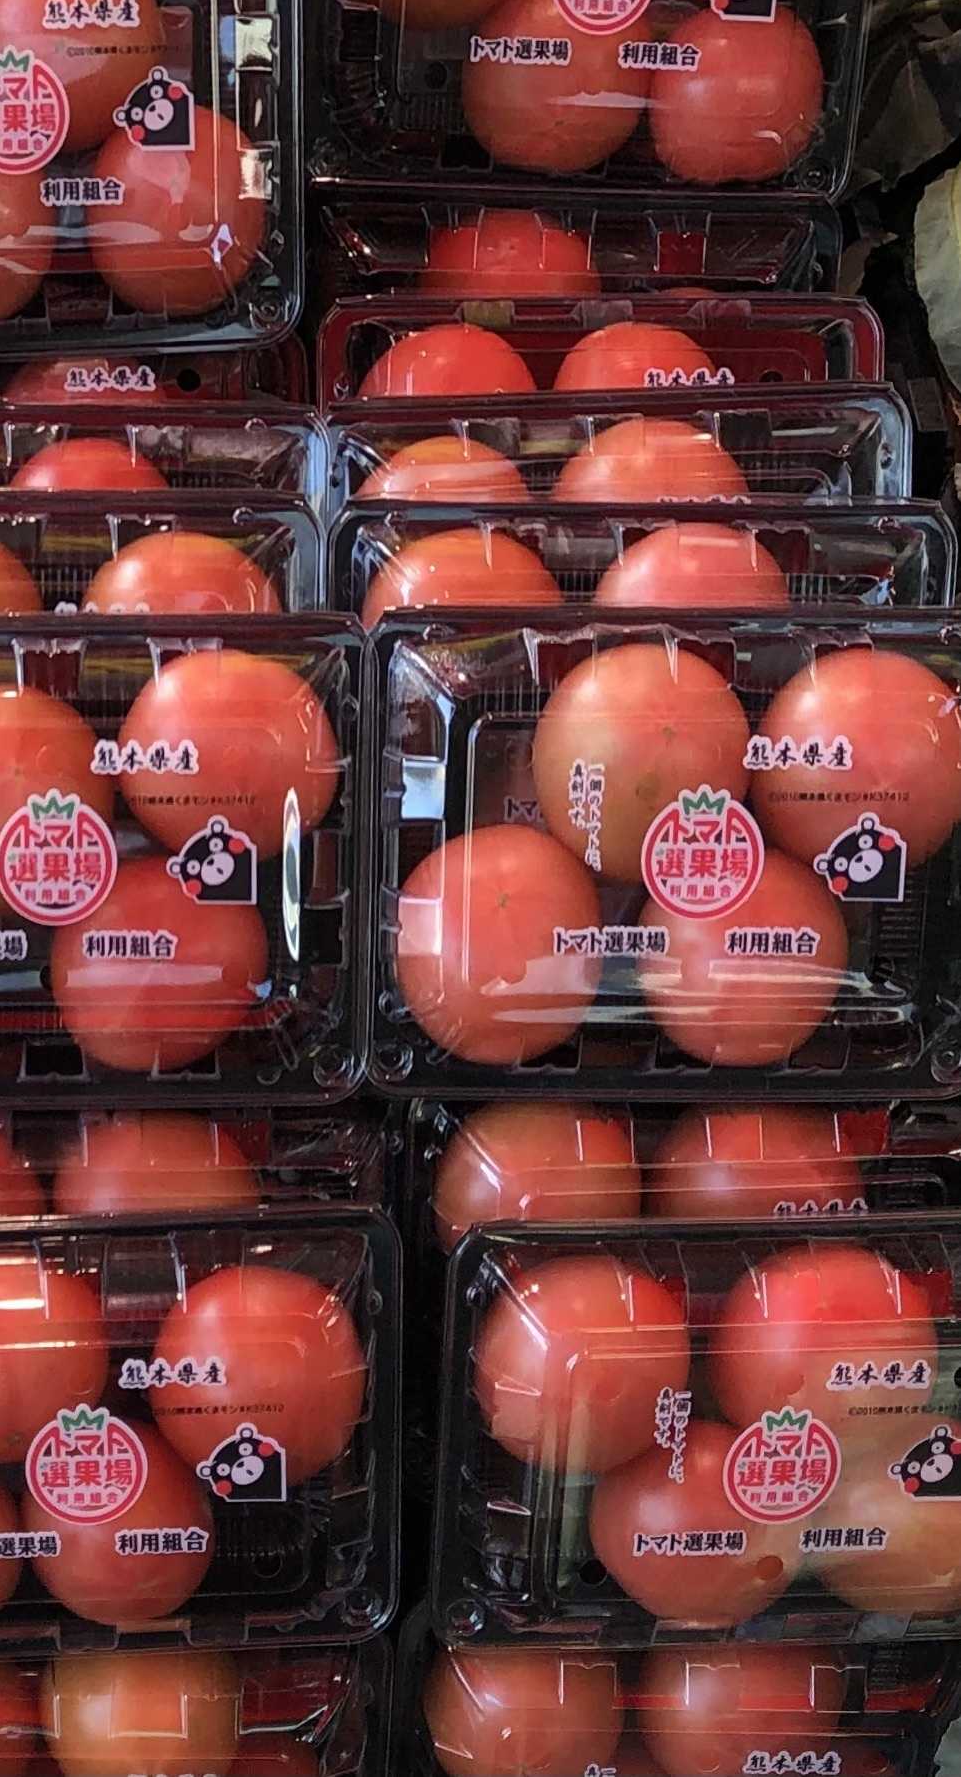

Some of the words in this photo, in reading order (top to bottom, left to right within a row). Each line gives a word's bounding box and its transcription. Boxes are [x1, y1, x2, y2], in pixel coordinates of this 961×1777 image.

[472, 39, 569, 62] トマト選果場
[621, 44, 699, 67] 利用組合
[43, 180, 122, 202] 利用組合
[66, 368, 153, 388] 熊本県産
[94, 743, 196, 771] 熊本県産
[747, 741, 850, 768] 熊本県産
[23, 822, 95, 849] トマト
[671, 818, 743, 844] トマト
[9, 852, 102, 882] 選果場
[656, 848, 749, 878] 選果場
[85, 933, 175, 957] 利用組合
[555, 930, 667, 954] トマト選果場
[728, 930, 818, 954] 利用組合
[122, 1362, 225, 1387] 熊本県産
[829, 1363, 929, 1388] 熊本県産
[54, 1433, 125, 1458] トマト
[755, 1433, 823, 1457] トマト
[41, 1459, 133, 1487] 選果場
[737, 1458, 828, 1487] 選果場
[118, 1529, 208, 1554] 利用組合
[636, 1532, 744, 1555] トマト選果場
[801, 1528, 888, 1551] 利用組合
[747, 1753, 838, 1773] 熊本県産
